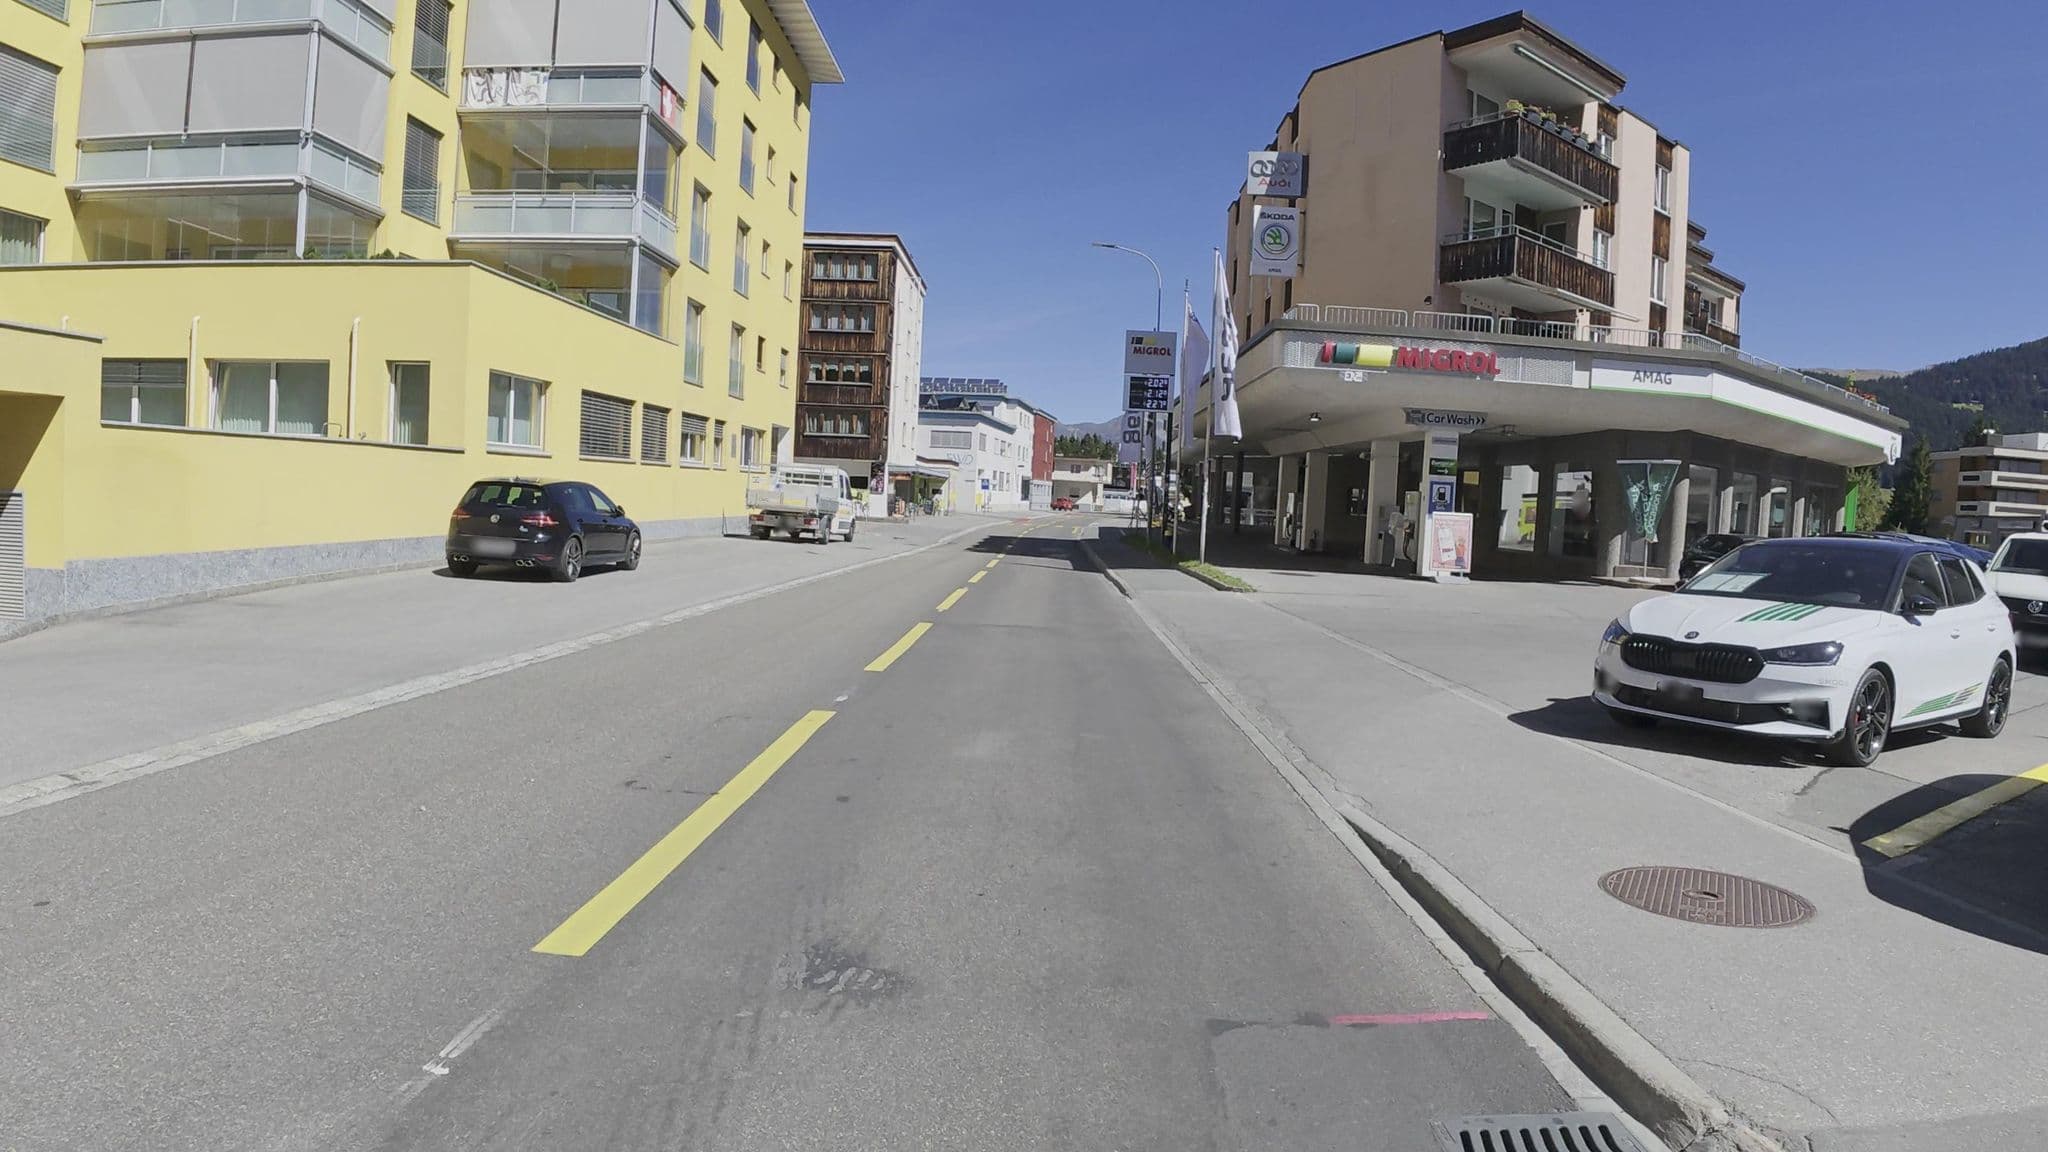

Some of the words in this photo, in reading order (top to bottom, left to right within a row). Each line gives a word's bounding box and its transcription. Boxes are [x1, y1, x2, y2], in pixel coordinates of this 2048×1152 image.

[1132, 346, 1171, 356] MIGROL
[1396, 345, 1501, 375] MIGROL
[1632, 370, 1672, 385] AMAG
[1426, 413, 1446, 423] Car
[1446, 414, 1474, 425] Wash
[1123, 415, 1141, 444] ag
